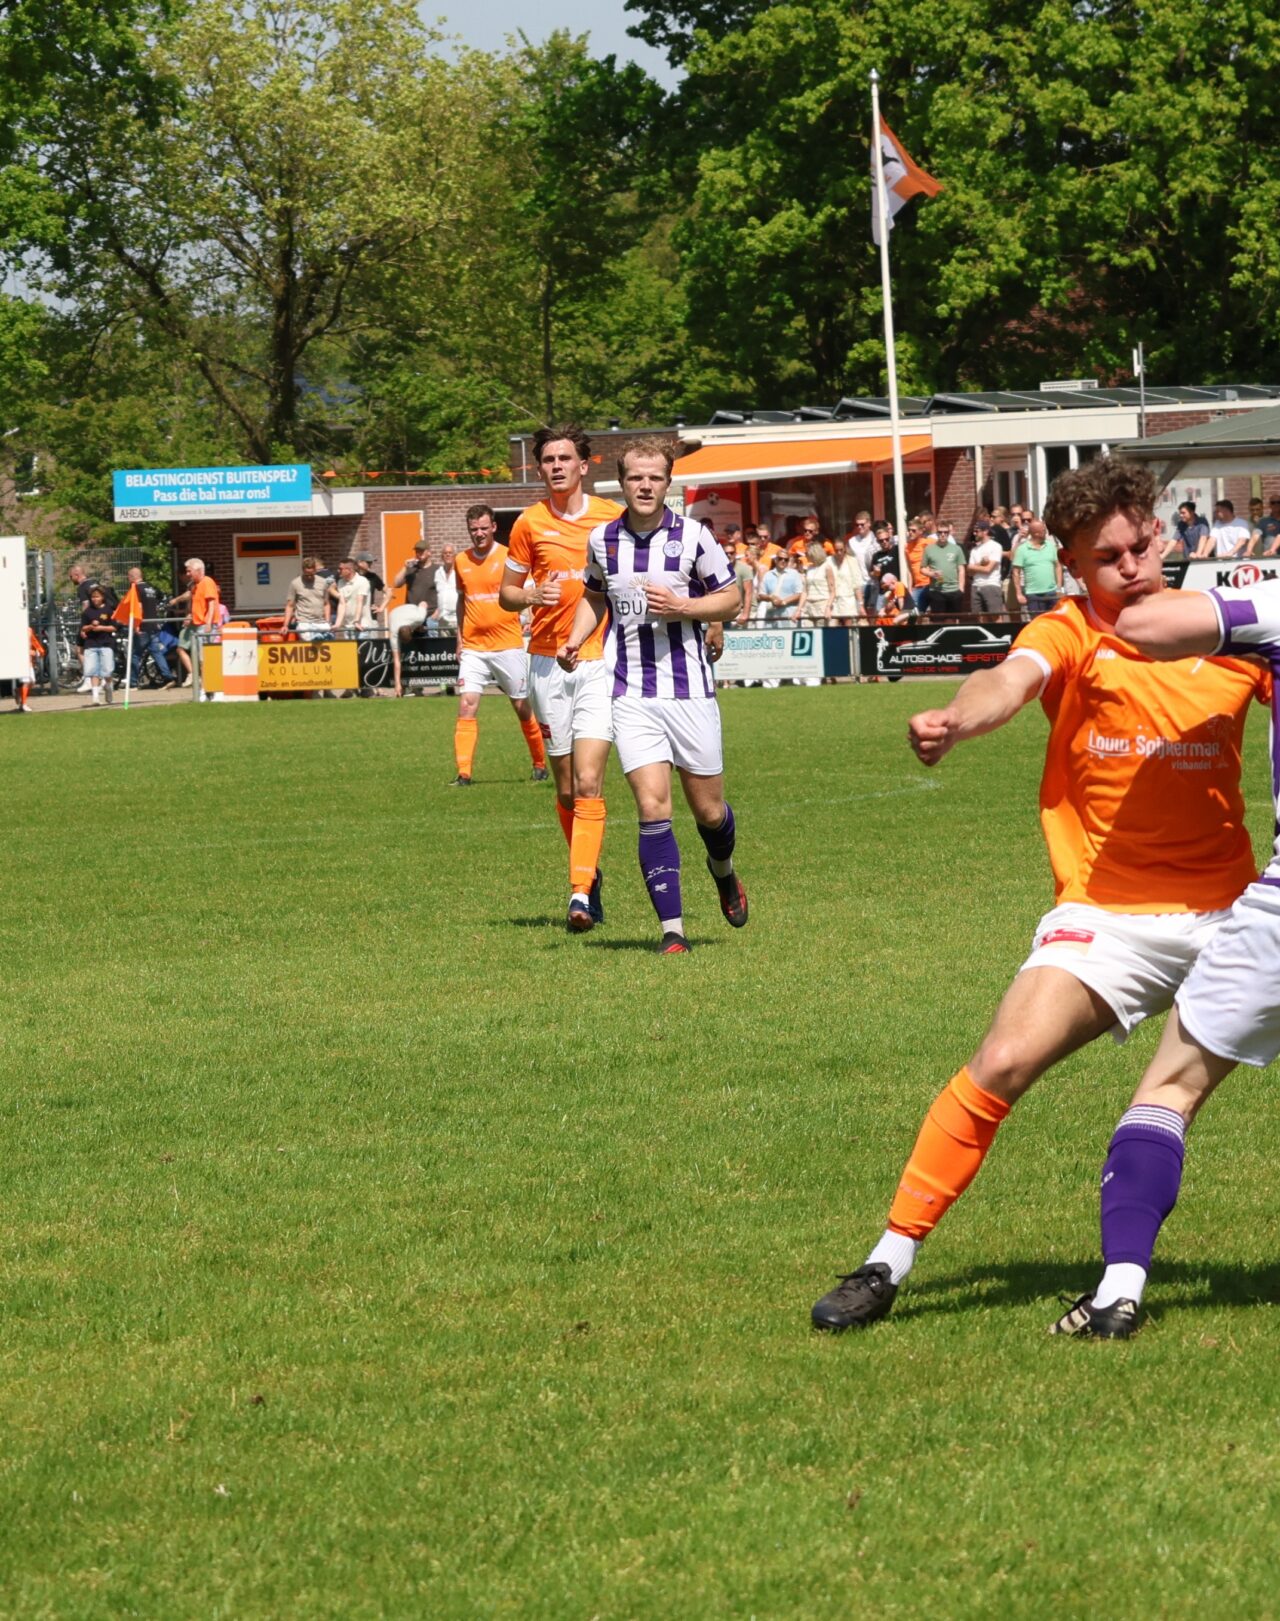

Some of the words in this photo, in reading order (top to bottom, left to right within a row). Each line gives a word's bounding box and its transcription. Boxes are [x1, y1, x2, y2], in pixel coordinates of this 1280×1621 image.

[125, 471, 224, 487] BELASTINGDIENST
[226, 469, 298, 485] BUITENSPEL?
[153, 489, 178, 502] Pass
[179, 487, 197, 501] die
[198, 487, 216, 500] bal
[218, 489, 246, 500] naar
[246, 486, 271, 499] ons!
[119, 508, 150, 519] AHEAD
[268, 645, 332, 664] SMIDS
[268, 665, 333, 676] KOLLUM
[260, 680, 279, 688] Zand-
[290, 678, 333, 687] Grondhandel
[1135, 734, 1220, 759] Spijkerman
[1171, 759, 1212, 770] vishandel
